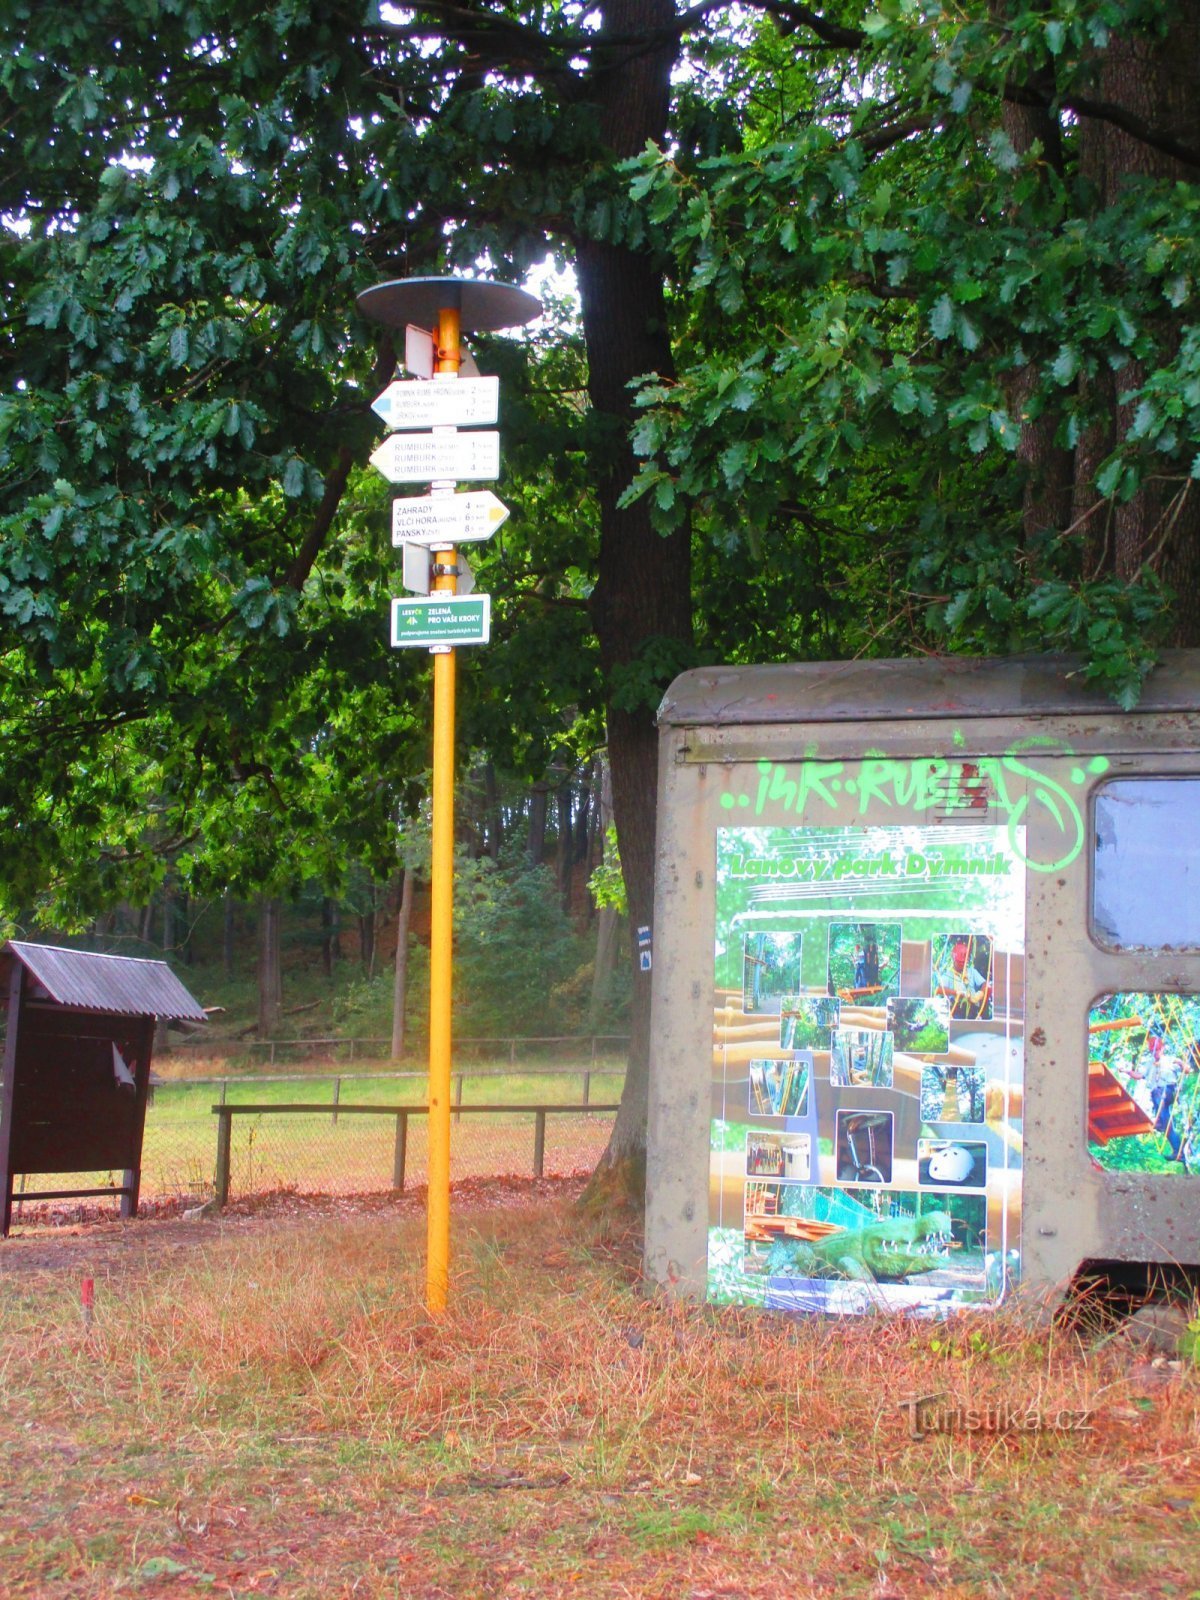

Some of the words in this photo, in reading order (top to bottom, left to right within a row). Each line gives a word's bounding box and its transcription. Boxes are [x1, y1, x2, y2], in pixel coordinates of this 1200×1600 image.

[394, 441, 437, 452] RUMBURK
[394, 453, 437, 463] RUMBURK
[394, 465, 437, 475] RUMBURK
[397, 505, 433, 516] ZAHRADY
[428, 606, 452, 616] ZELENÁ
[442, 615, 458, 623] VAŠE
[459, 614, 480, 622] KROKY
[833, 851, 898, 881] park
